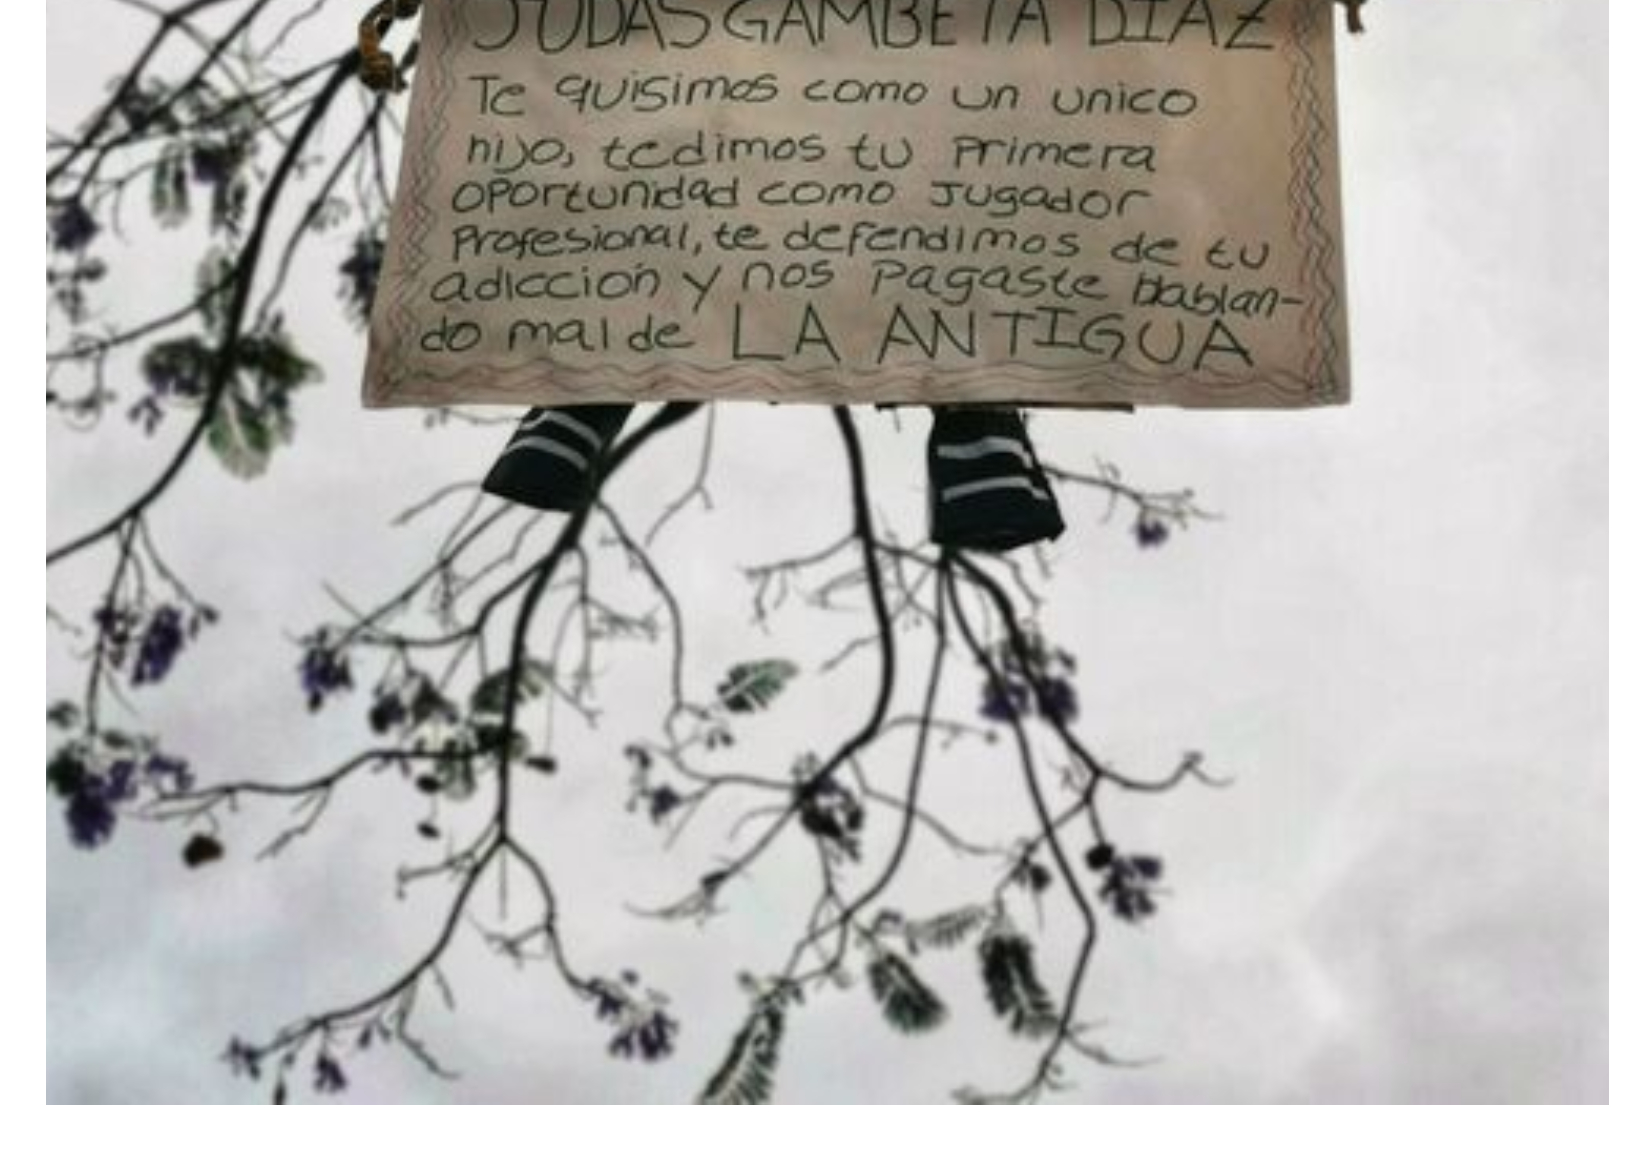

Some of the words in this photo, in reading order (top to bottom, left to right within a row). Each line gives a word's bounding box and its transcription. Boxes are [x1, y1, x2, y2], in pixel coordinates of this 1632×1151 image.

[469, 75, 526, 116] Te
[555, 70, 779, 114] quisimos
[804, 79, 928, 107] como
[952, 84, 1020, 110] un
[1053, 82, 1198, 116] unico
[846, 133, 913, 172] tu
[758, 179, 894, 208] como
[713, 220, 770, 250] te
[783, 219, 1081, 257] defendimos
[1110, 232, 1182, 267] de
[1206, 237, 1270, 270] tu
[742, 258, 836, 291] nos
[420, 315, 483, 352] do
[627, 314, 696, 352] de
[732, 301, 841, 364] LA
[878, 303, 1254, 369] ANTIGUA
